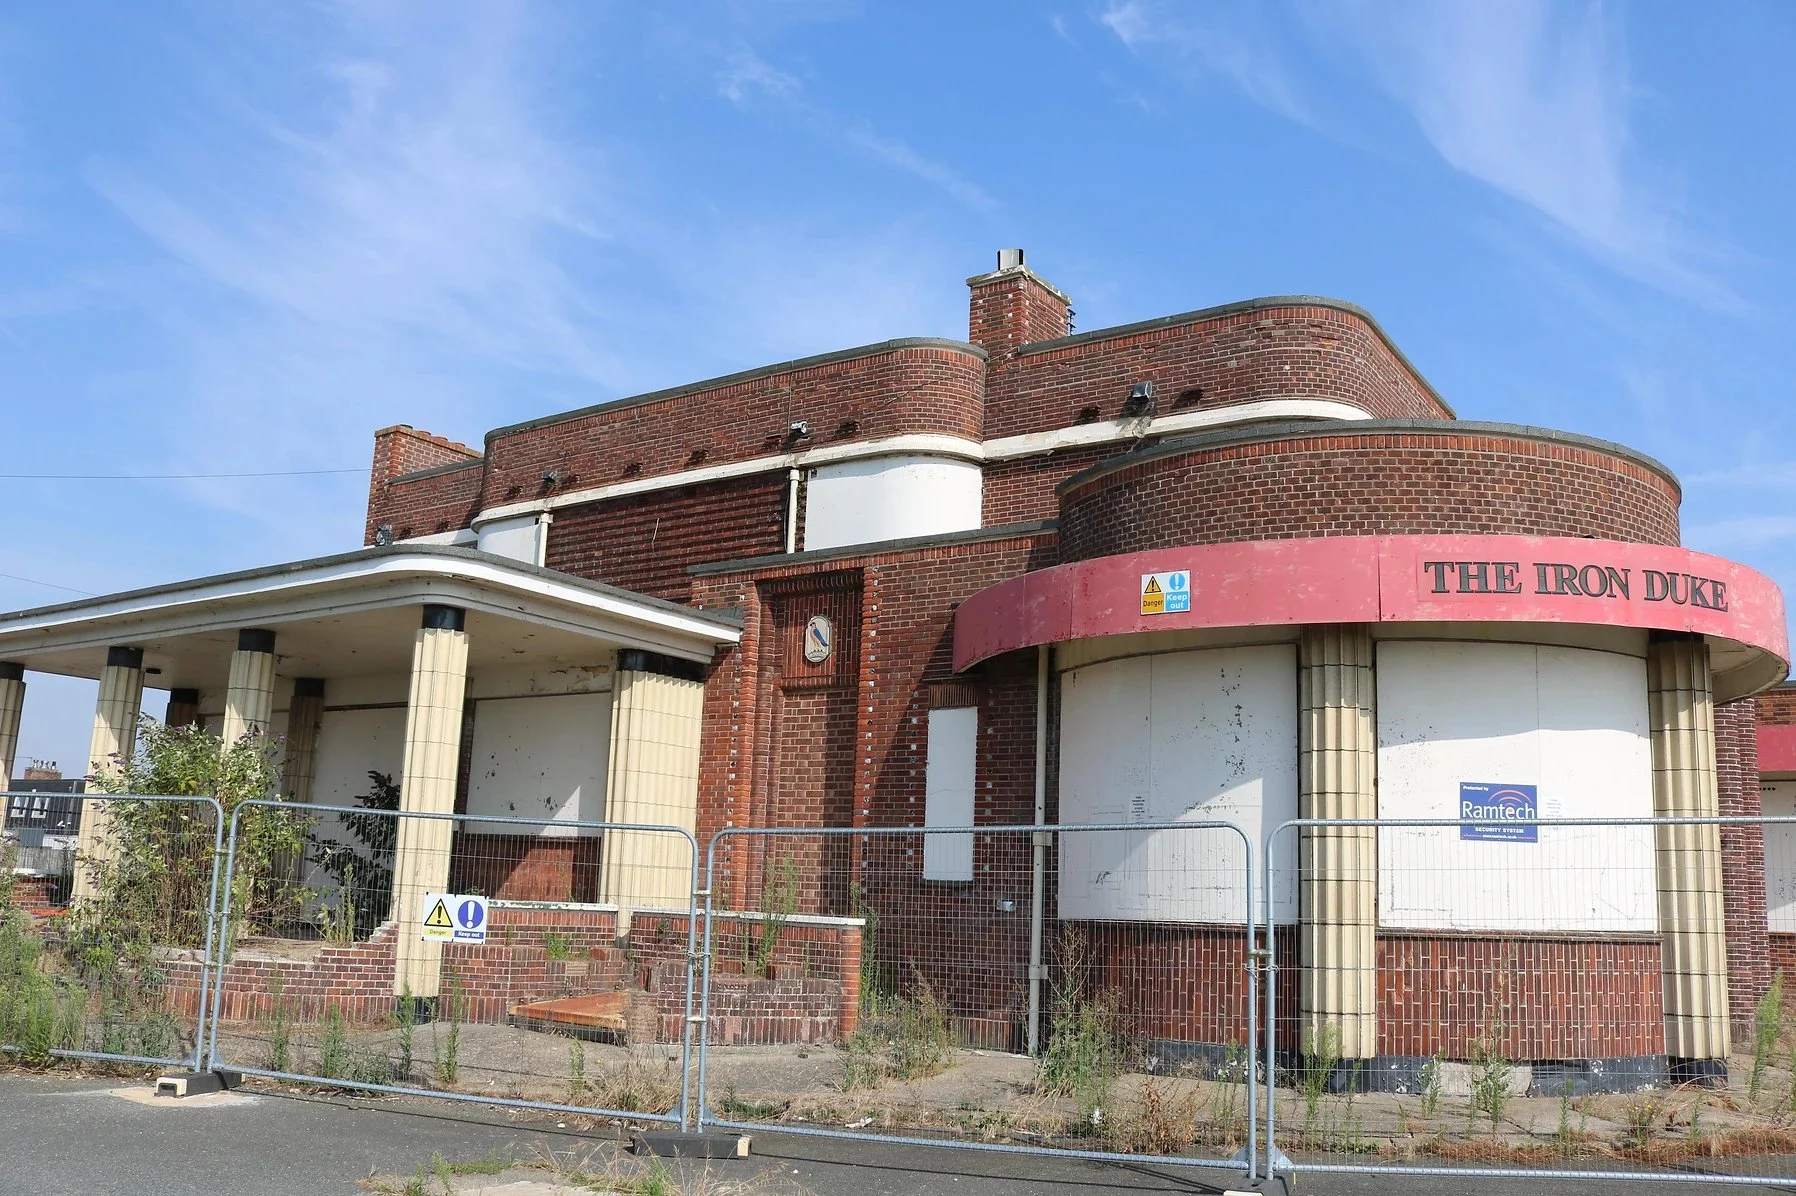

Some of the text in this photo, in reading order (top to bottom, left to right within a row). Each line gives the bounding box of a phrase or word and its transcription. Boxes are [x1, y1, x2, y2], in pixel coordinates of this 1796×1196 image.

[1424, 561, 1728, 612] THE IRON DUKE
[1462, 801, 1535, 819] Ramtech
